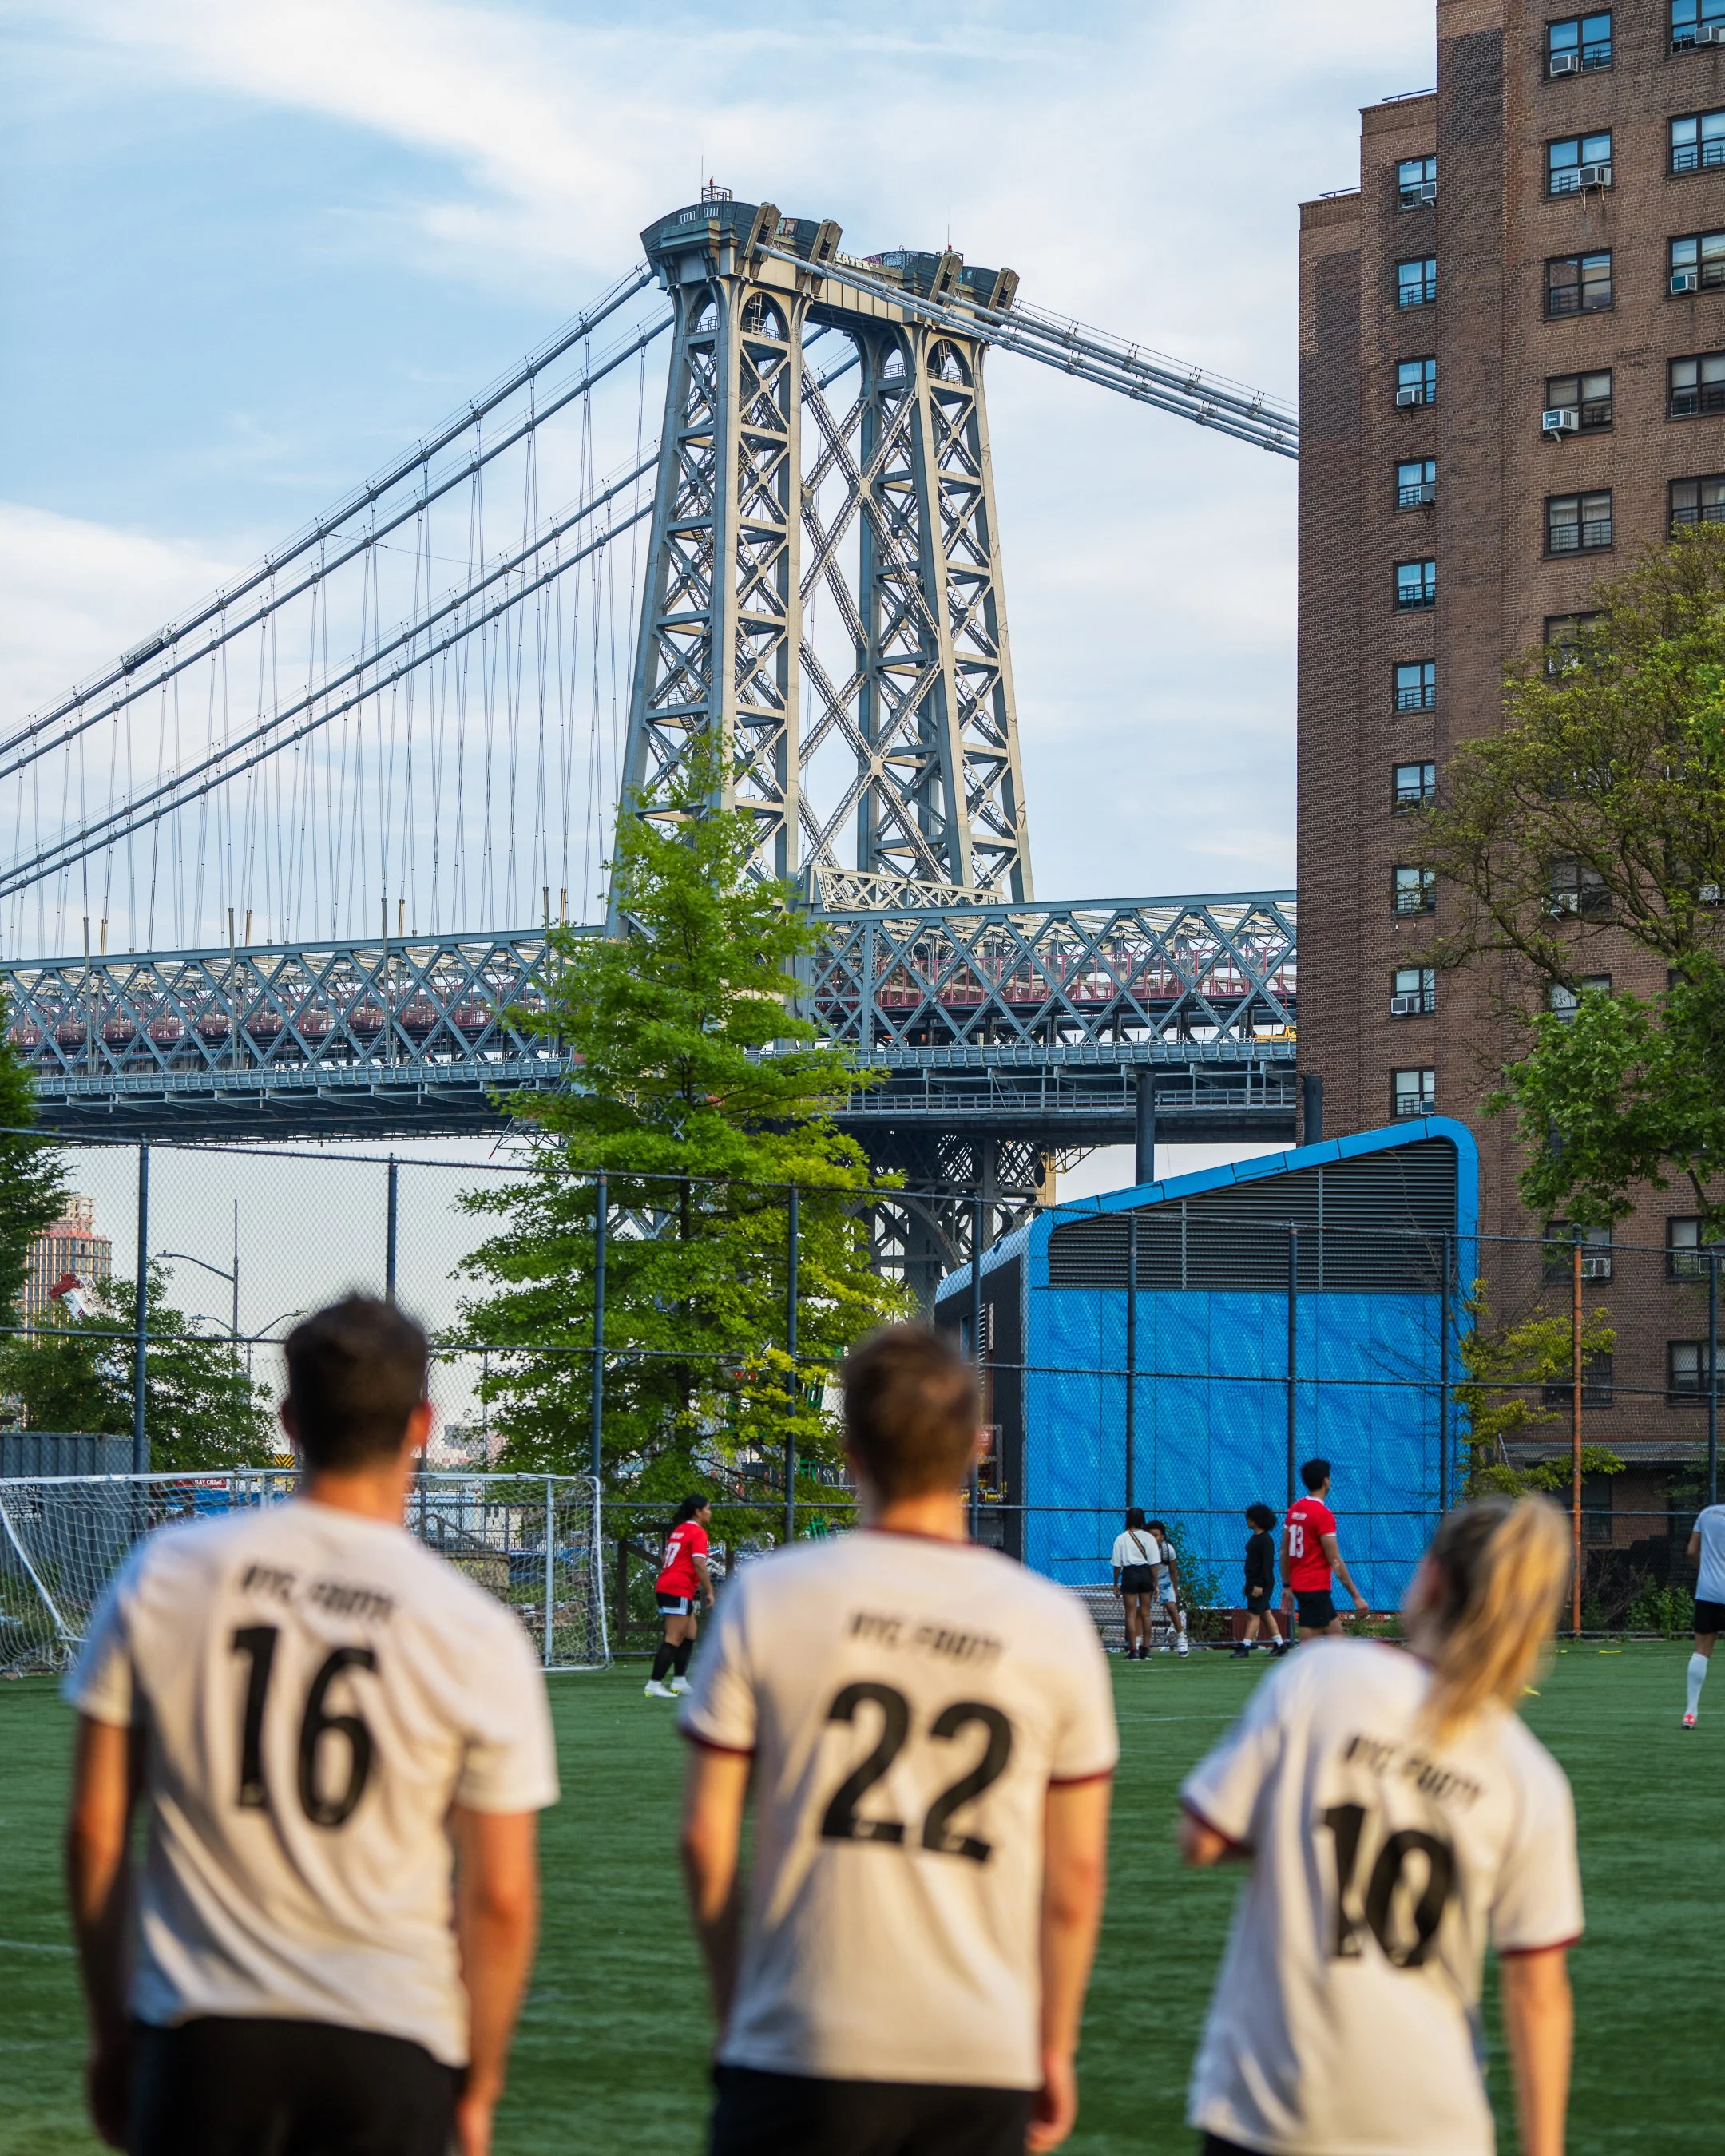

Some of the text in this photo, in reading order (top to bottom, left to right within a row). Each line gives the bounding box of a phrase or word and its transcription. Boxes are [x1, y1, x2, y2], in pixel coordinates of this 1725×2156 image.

[1288, 1524, 1304, 1559] 13
[232, 1625, 379, 1829] 16
[821, 1682, 1013, 1864] 22
[1324, 1803, 1457, 1969] 10
